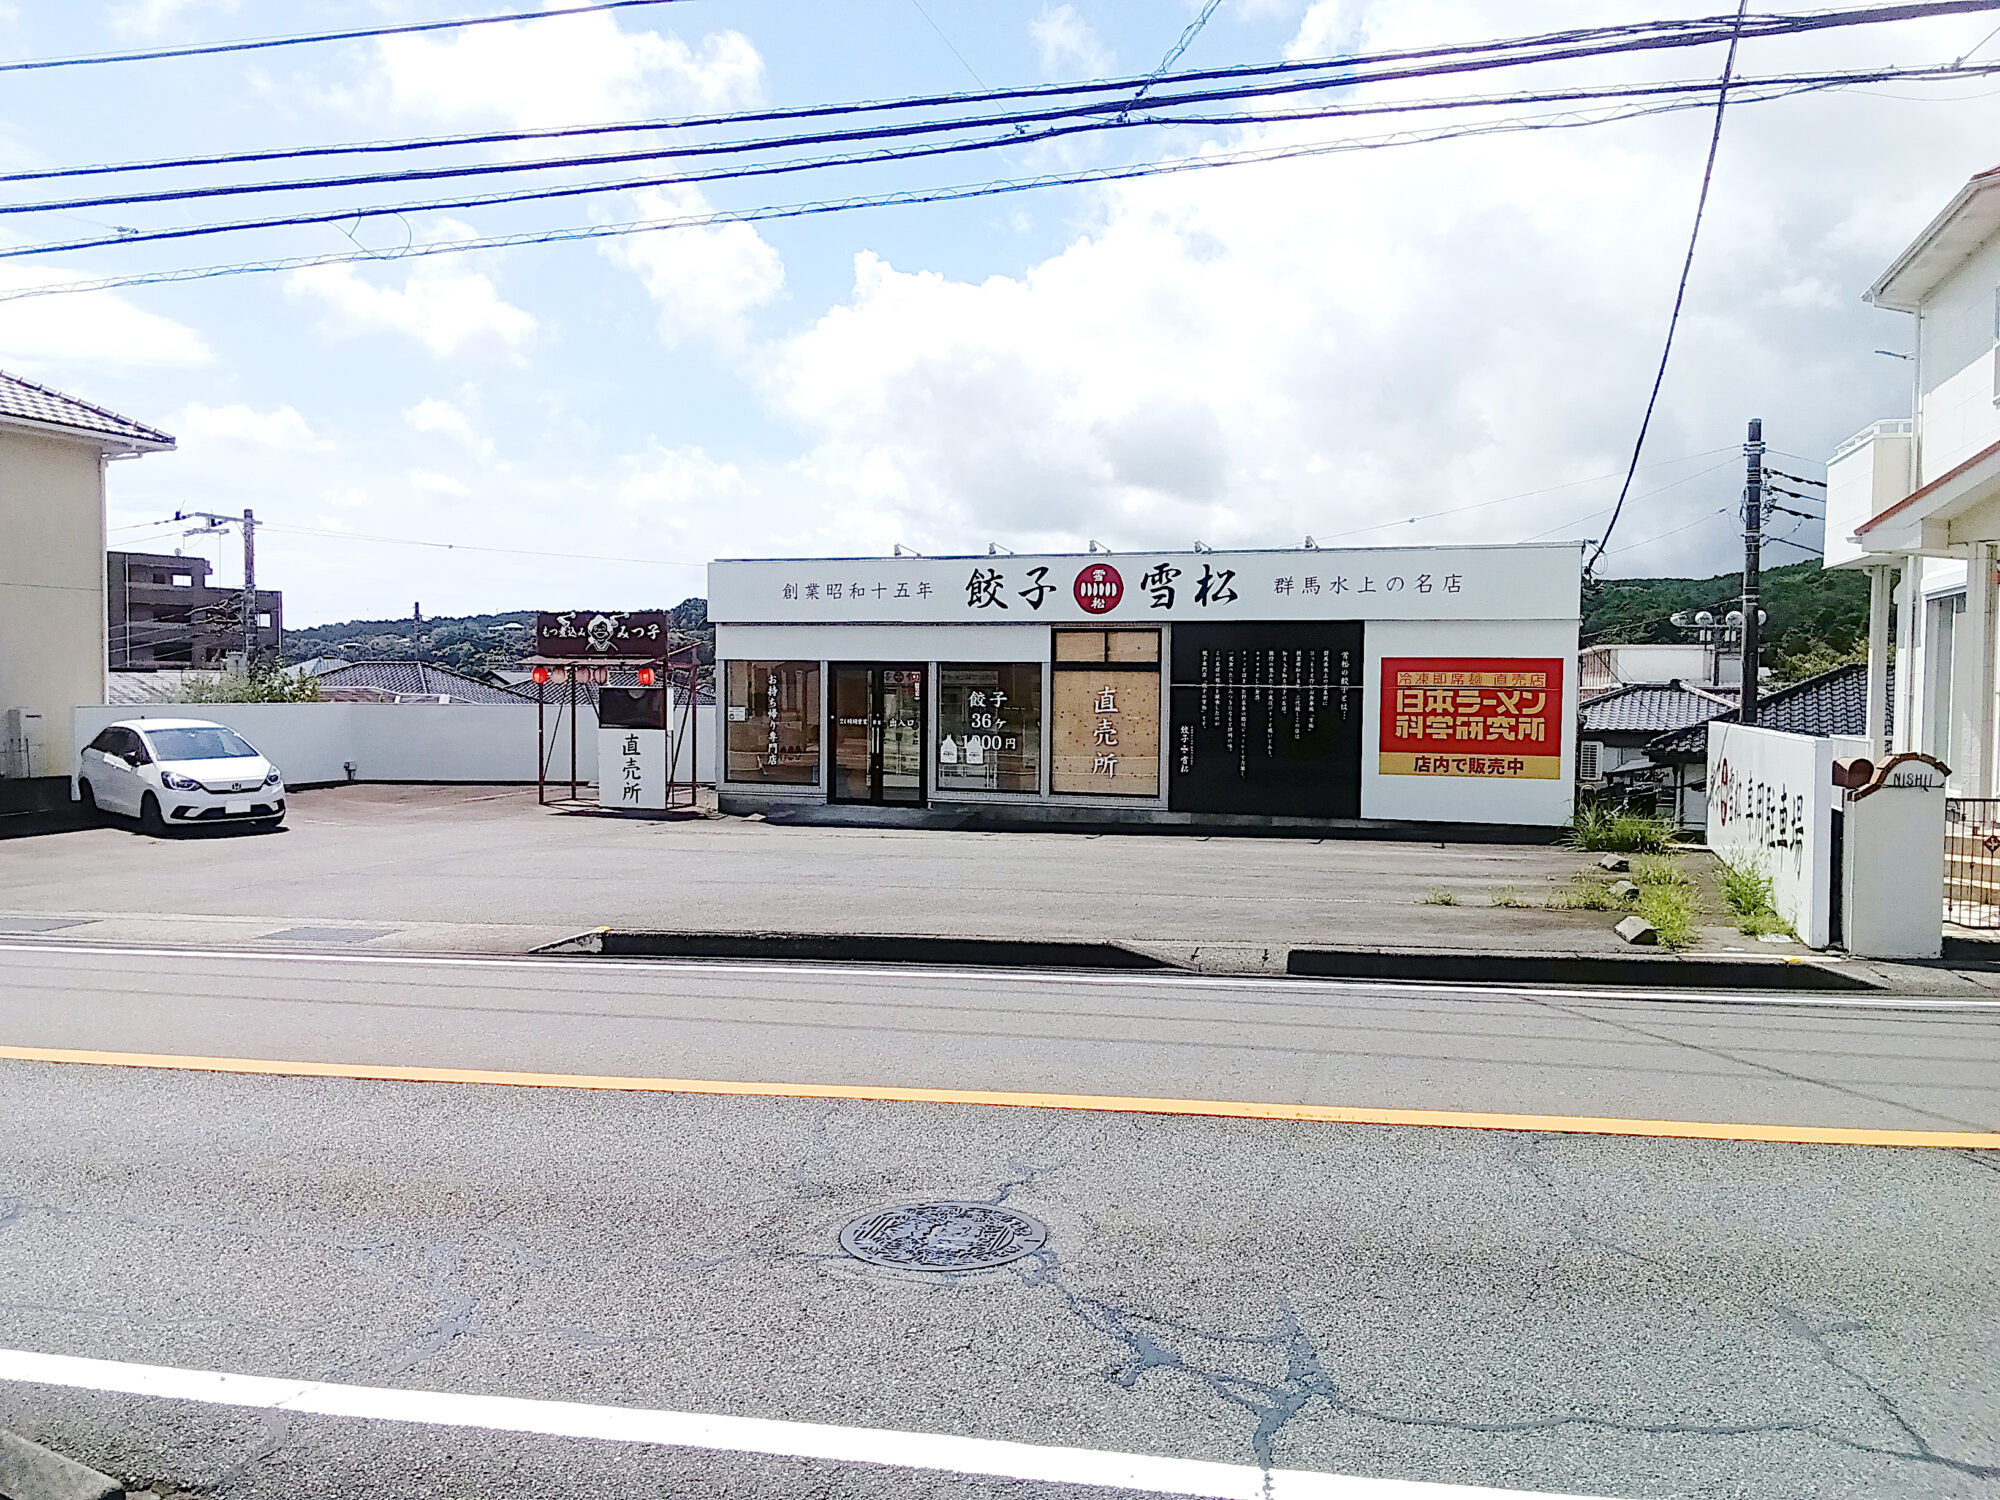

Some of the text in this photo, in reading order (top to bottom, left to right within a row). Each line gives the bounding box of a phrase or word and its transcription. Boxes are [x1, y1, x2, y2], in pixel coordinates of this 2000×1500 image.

[783, 582, 933, 600] 創業昭和十五年
[966, 562, 1239, 610] 餃子 雪松
[1273, 573, 1462, 596] 群馬水上の名店
[617, 623, 661, 640] みつ子
[1494, 673, 1545, 686] 直売店
[969, 691, 1008, 708] 餃子
[1396, 689, 1546, 715] 日本ラーメン
[767, 674, 779, 765] お持ち帰り専門店
[889, 718, 915, 728] 出入口
[1395, 715, 1545, 741] 科学研究所
[1093, 686, 1118, 779] 直売所
[622, 733, 642, 804] 直売所
[1414, 755, 1524, 775] 店内で販売中
